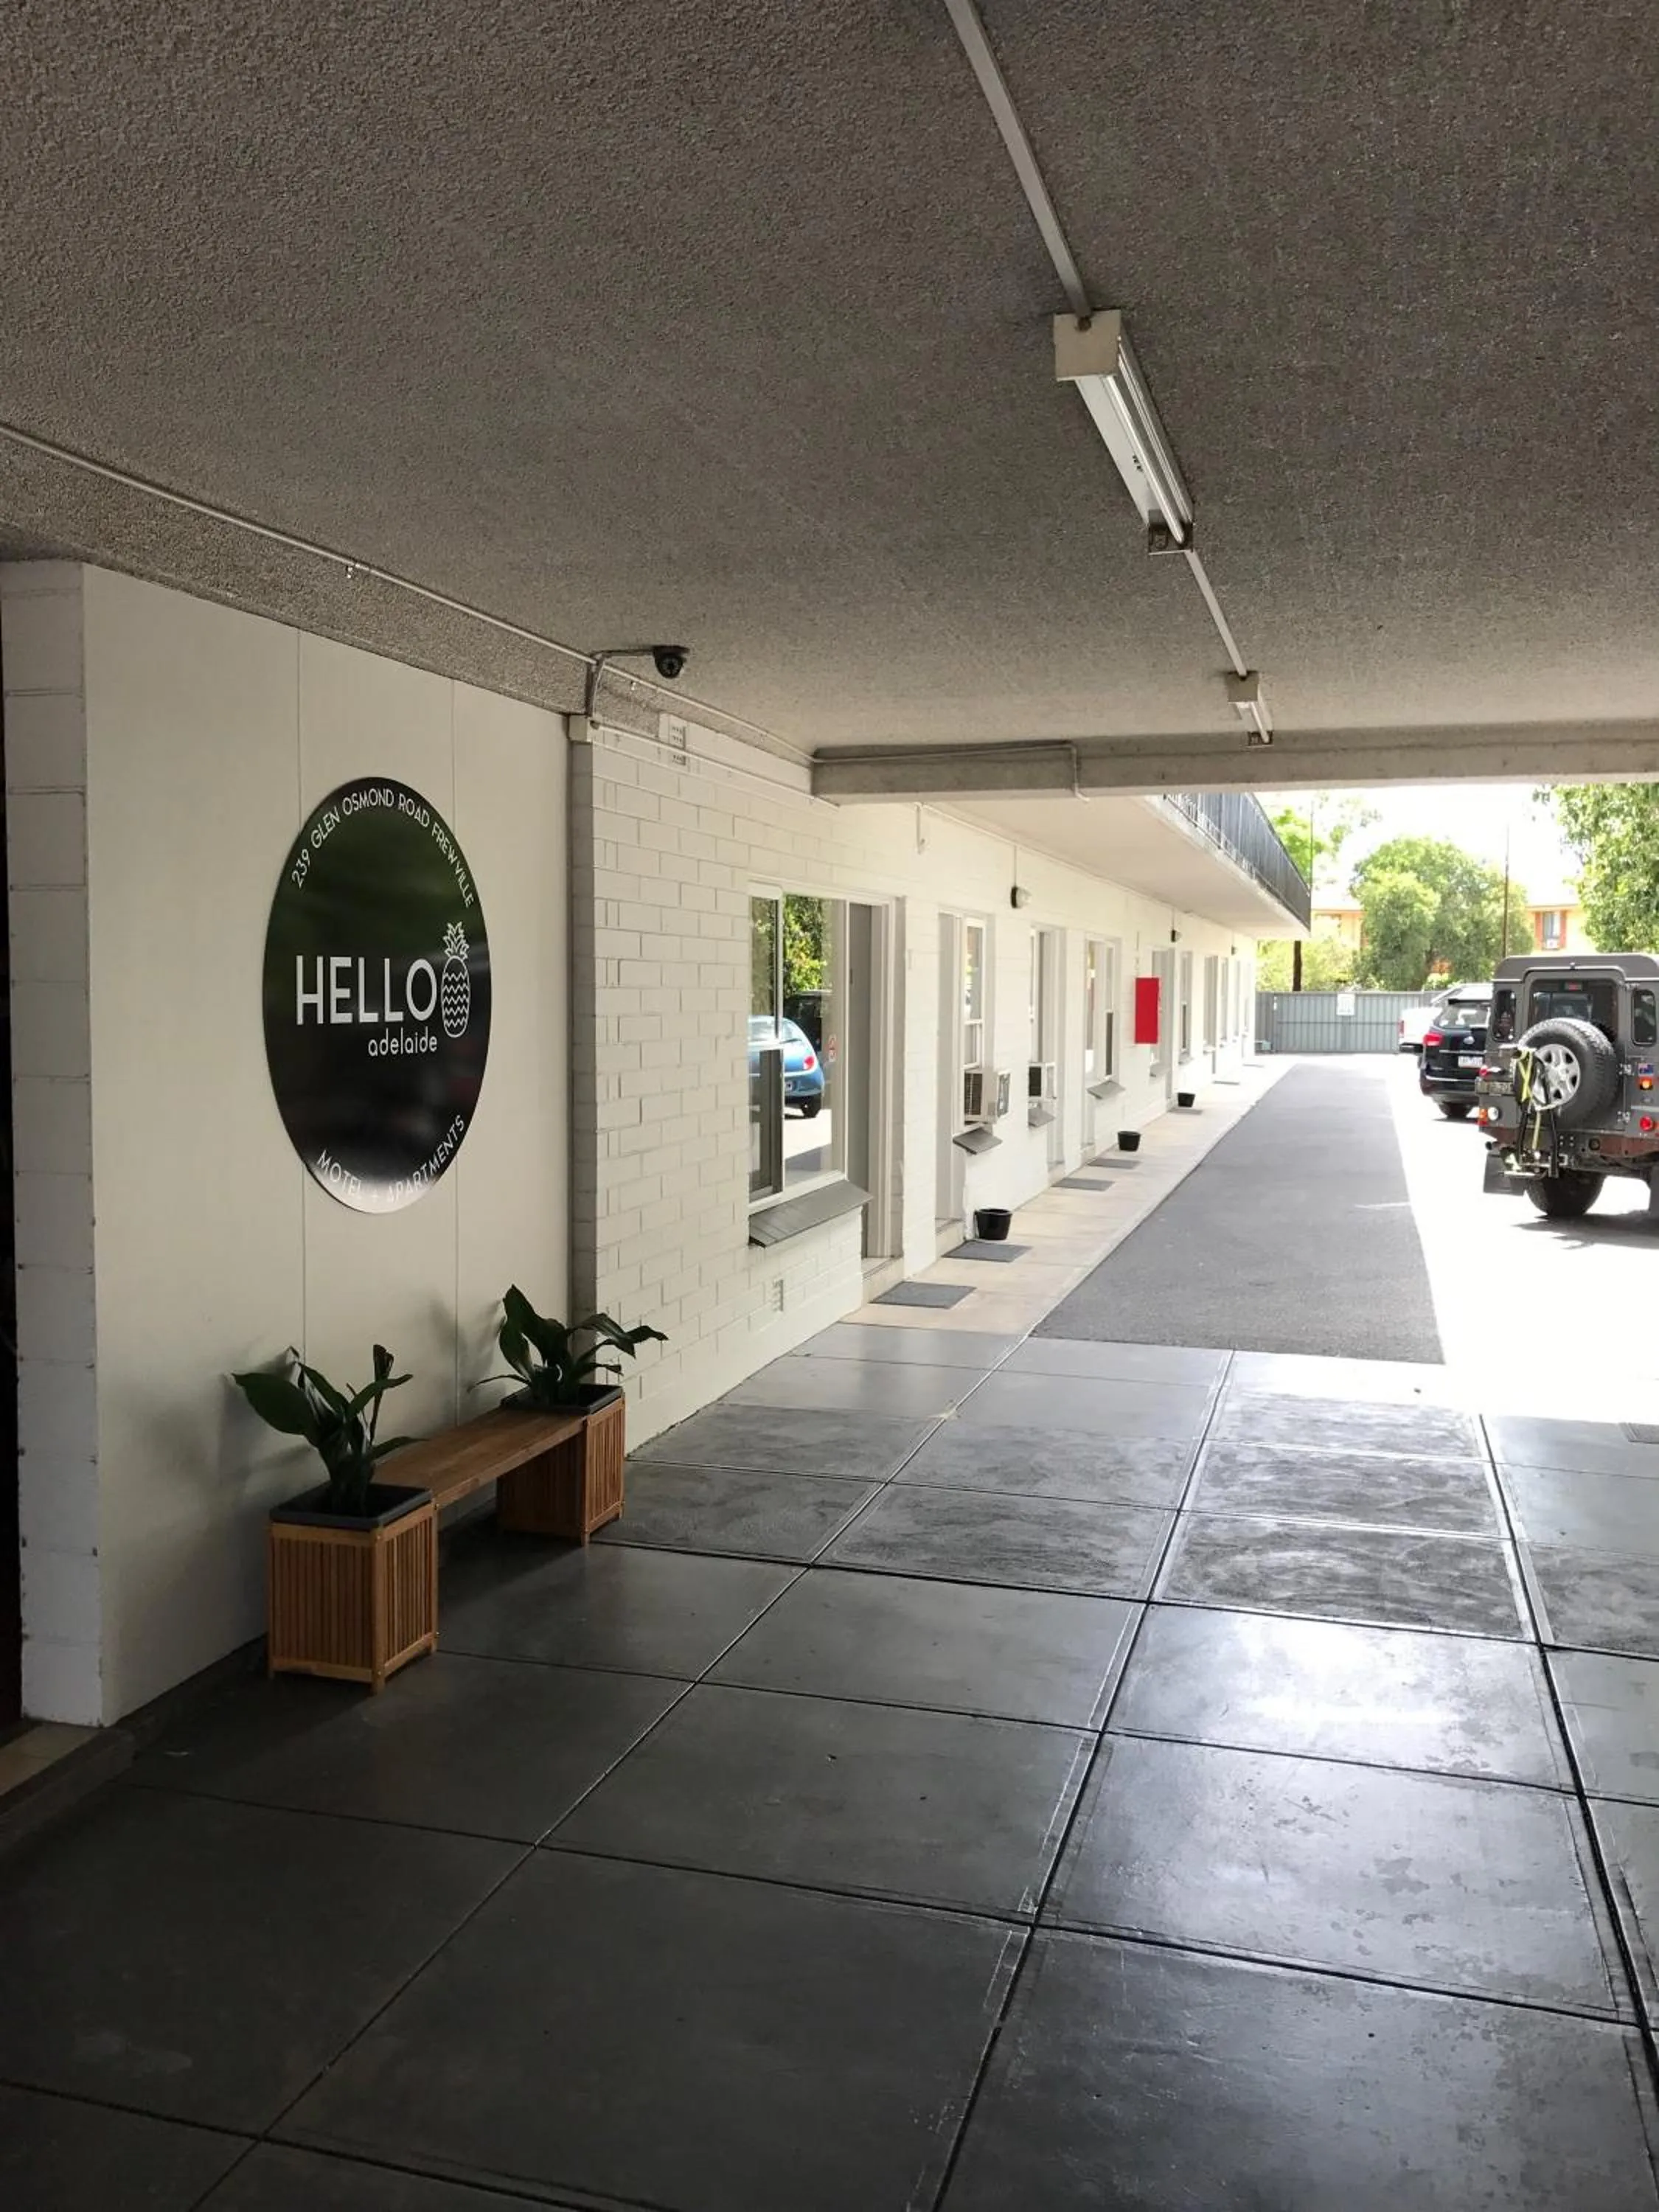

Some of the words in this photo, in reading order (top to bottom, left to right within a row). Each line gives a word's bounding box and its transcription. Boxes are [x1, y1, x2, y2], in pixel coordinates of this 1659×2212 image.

[291, 849, 310, 888] 239
[310, 806, 341, 849] GLEN
[342, 787, 394, 815] OSMOND
[398, 793, 431, 828] ROAD
[296, 955, 437, 1026] HELLO
[368, 1026, 438, 1057] adelaide
